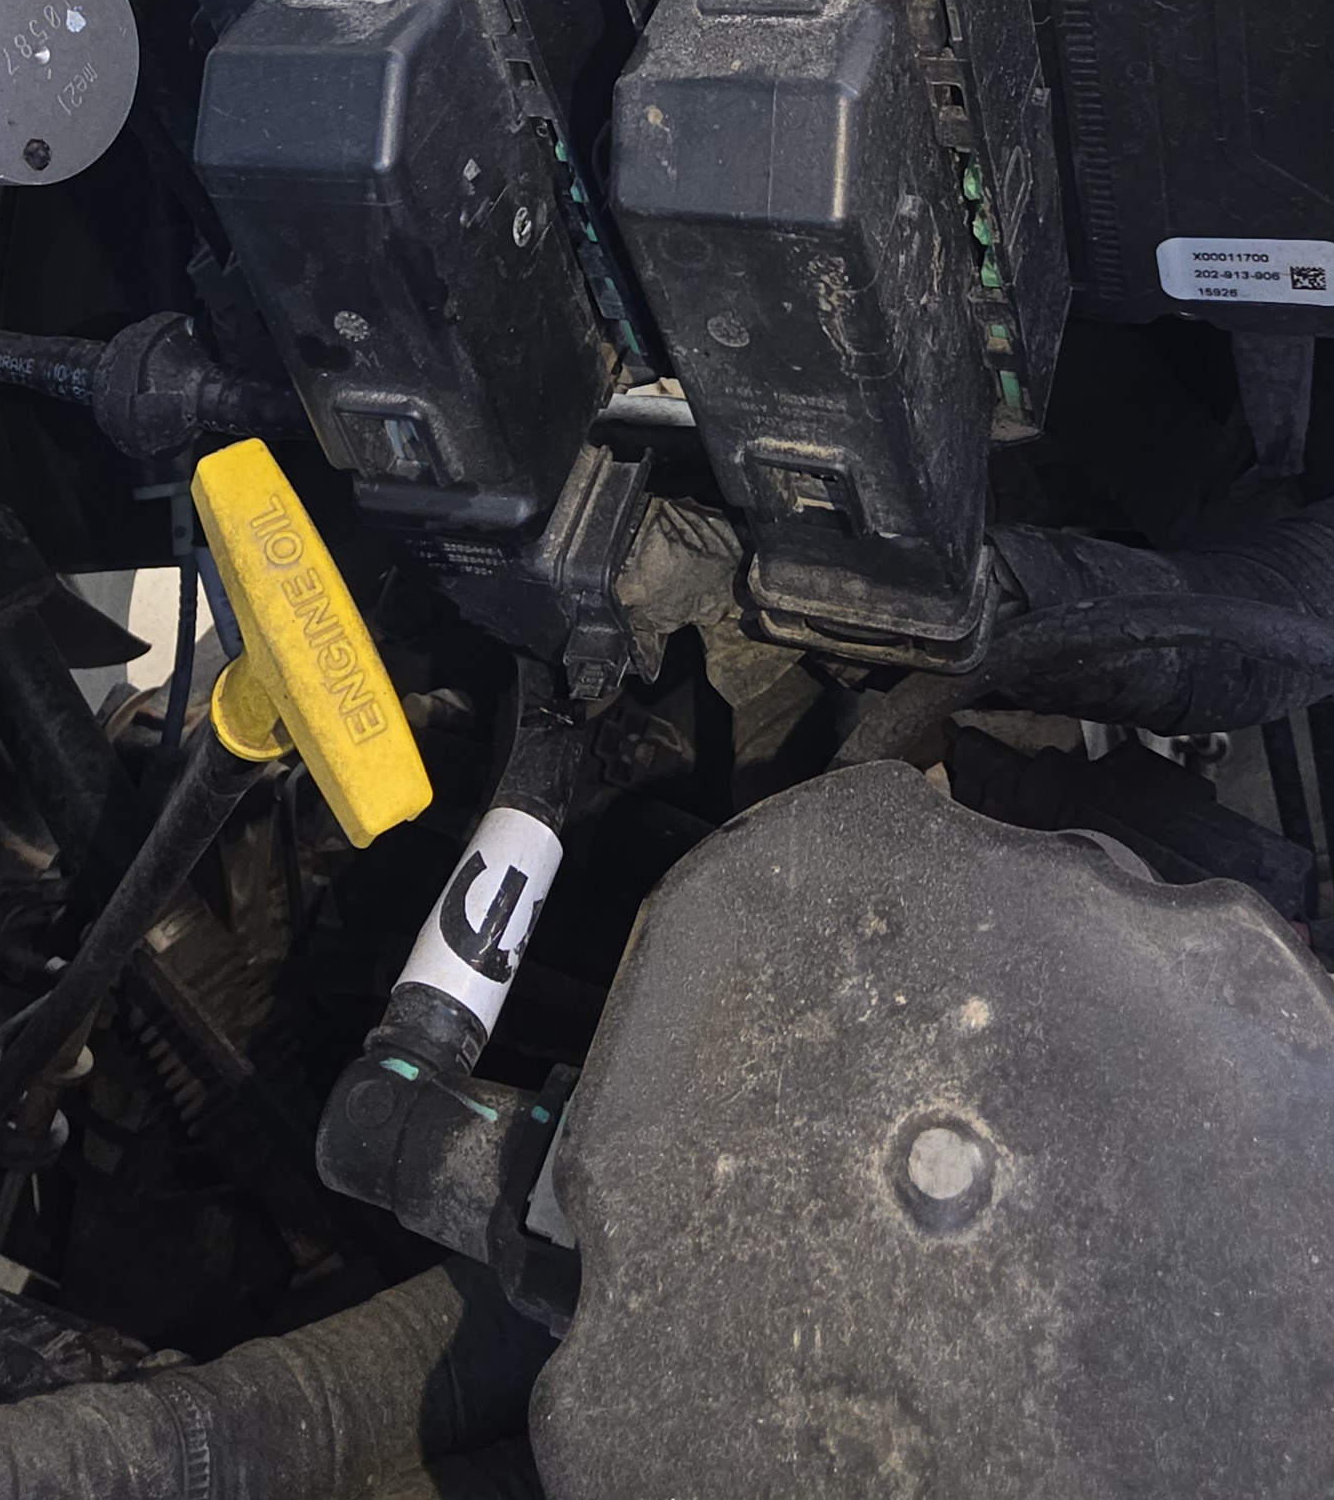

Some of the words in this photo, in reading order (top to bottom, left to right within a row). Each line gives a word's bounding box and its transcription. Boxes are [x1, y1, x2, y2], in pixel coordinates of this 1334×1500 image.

[1192, 252, 1269, 263] X00011700
[1194, 269, 1280, 281] 202-913-906
[1198, 287, 1238, 297] 15926
[250, 493, 305, 568] OIL
[281, 566, 388, 746] ENGINE
